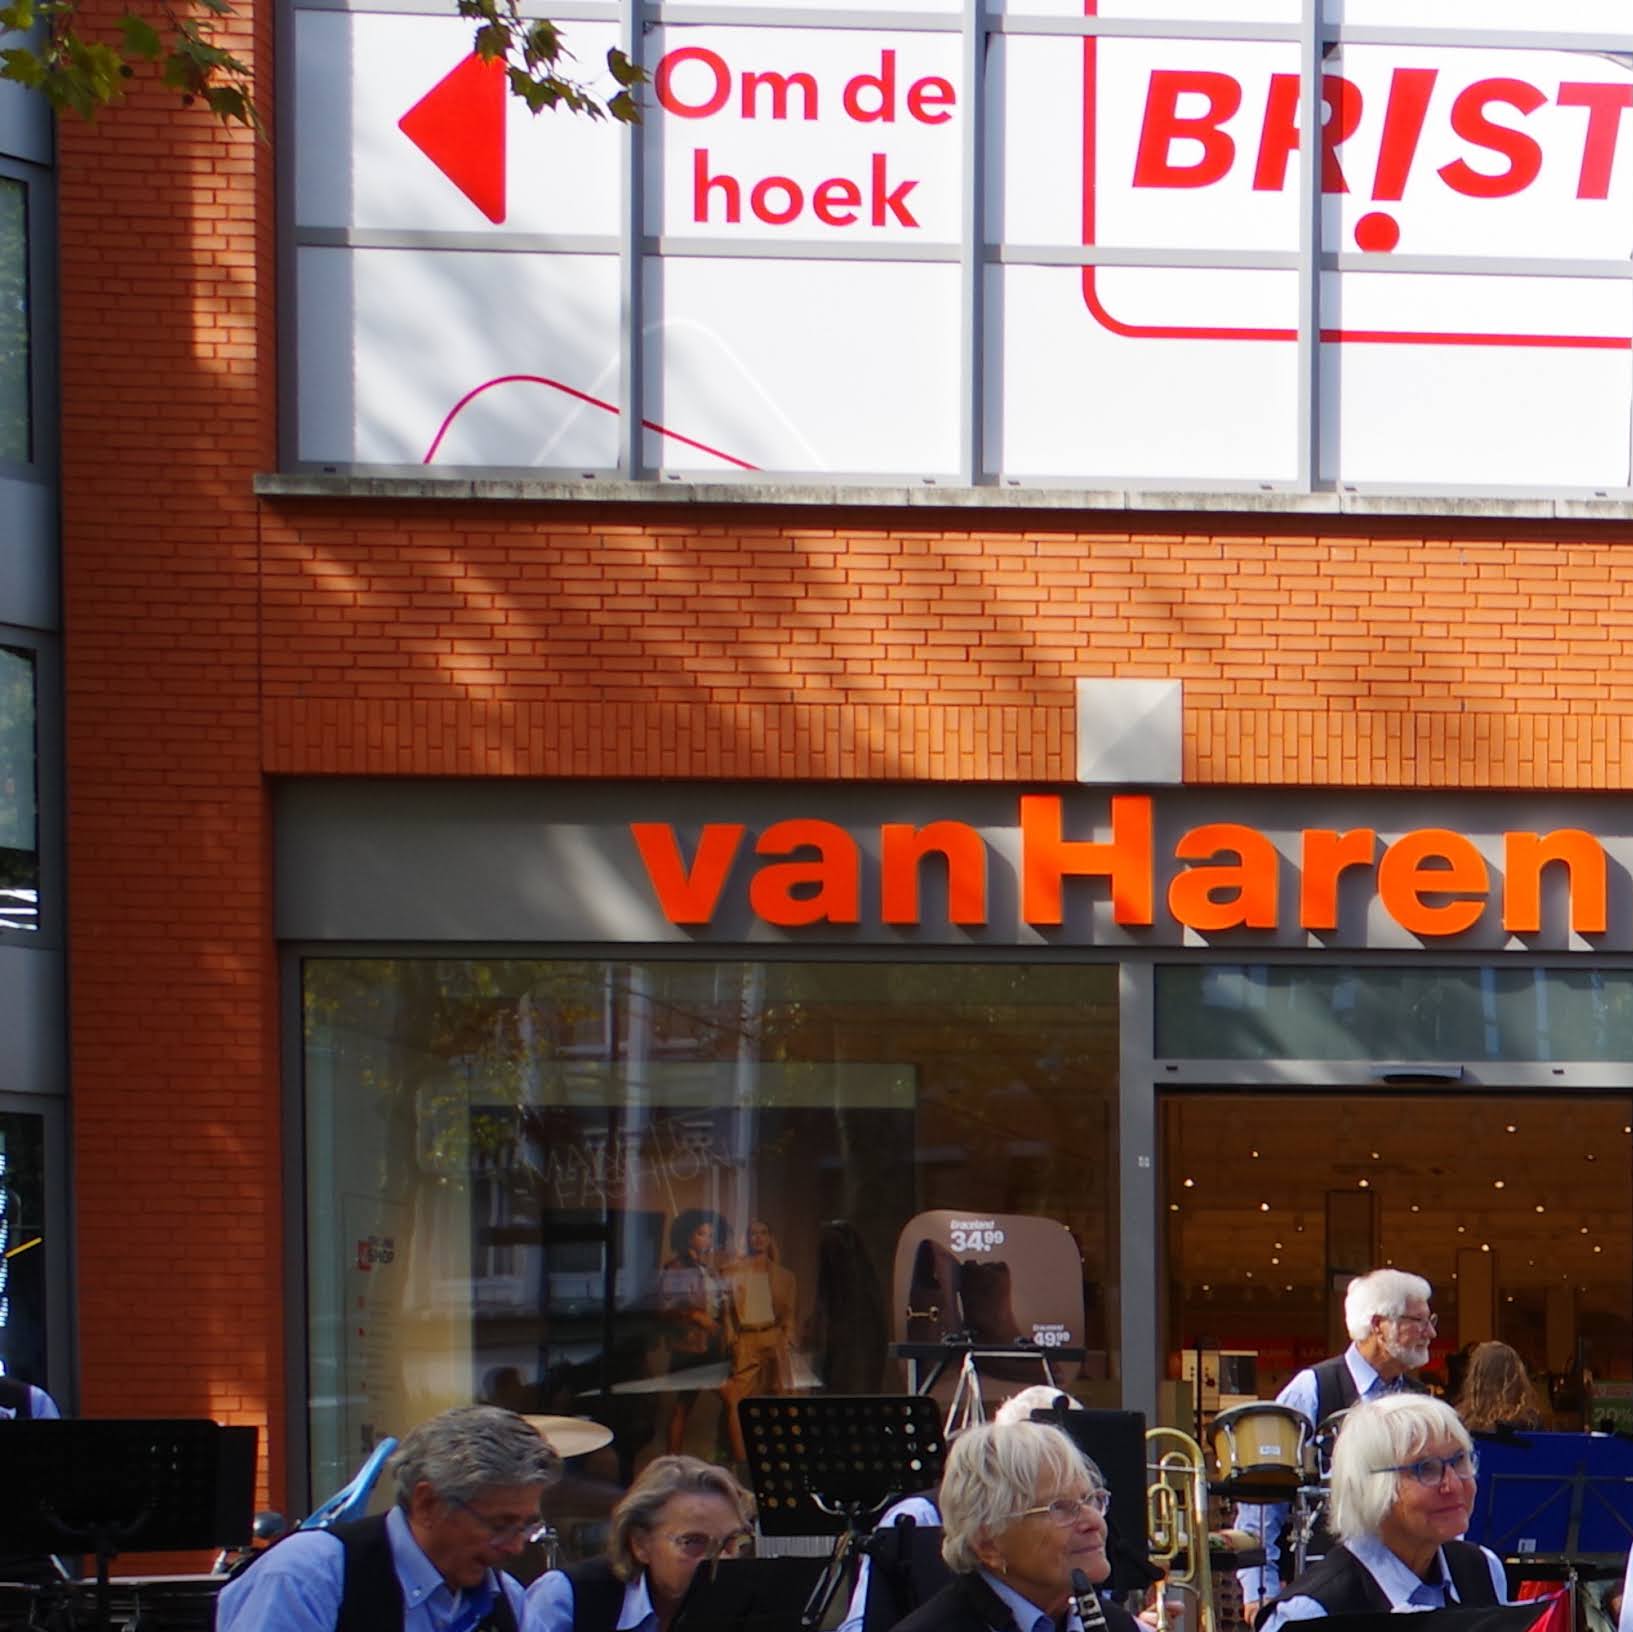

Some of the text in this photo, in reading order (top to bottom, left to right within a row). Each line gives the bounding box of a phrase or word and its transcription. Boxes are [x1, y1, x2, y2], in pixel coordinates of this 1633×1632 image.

[655, 46, 956, 125] Om de
[693, 148, 920, 228] hoek
